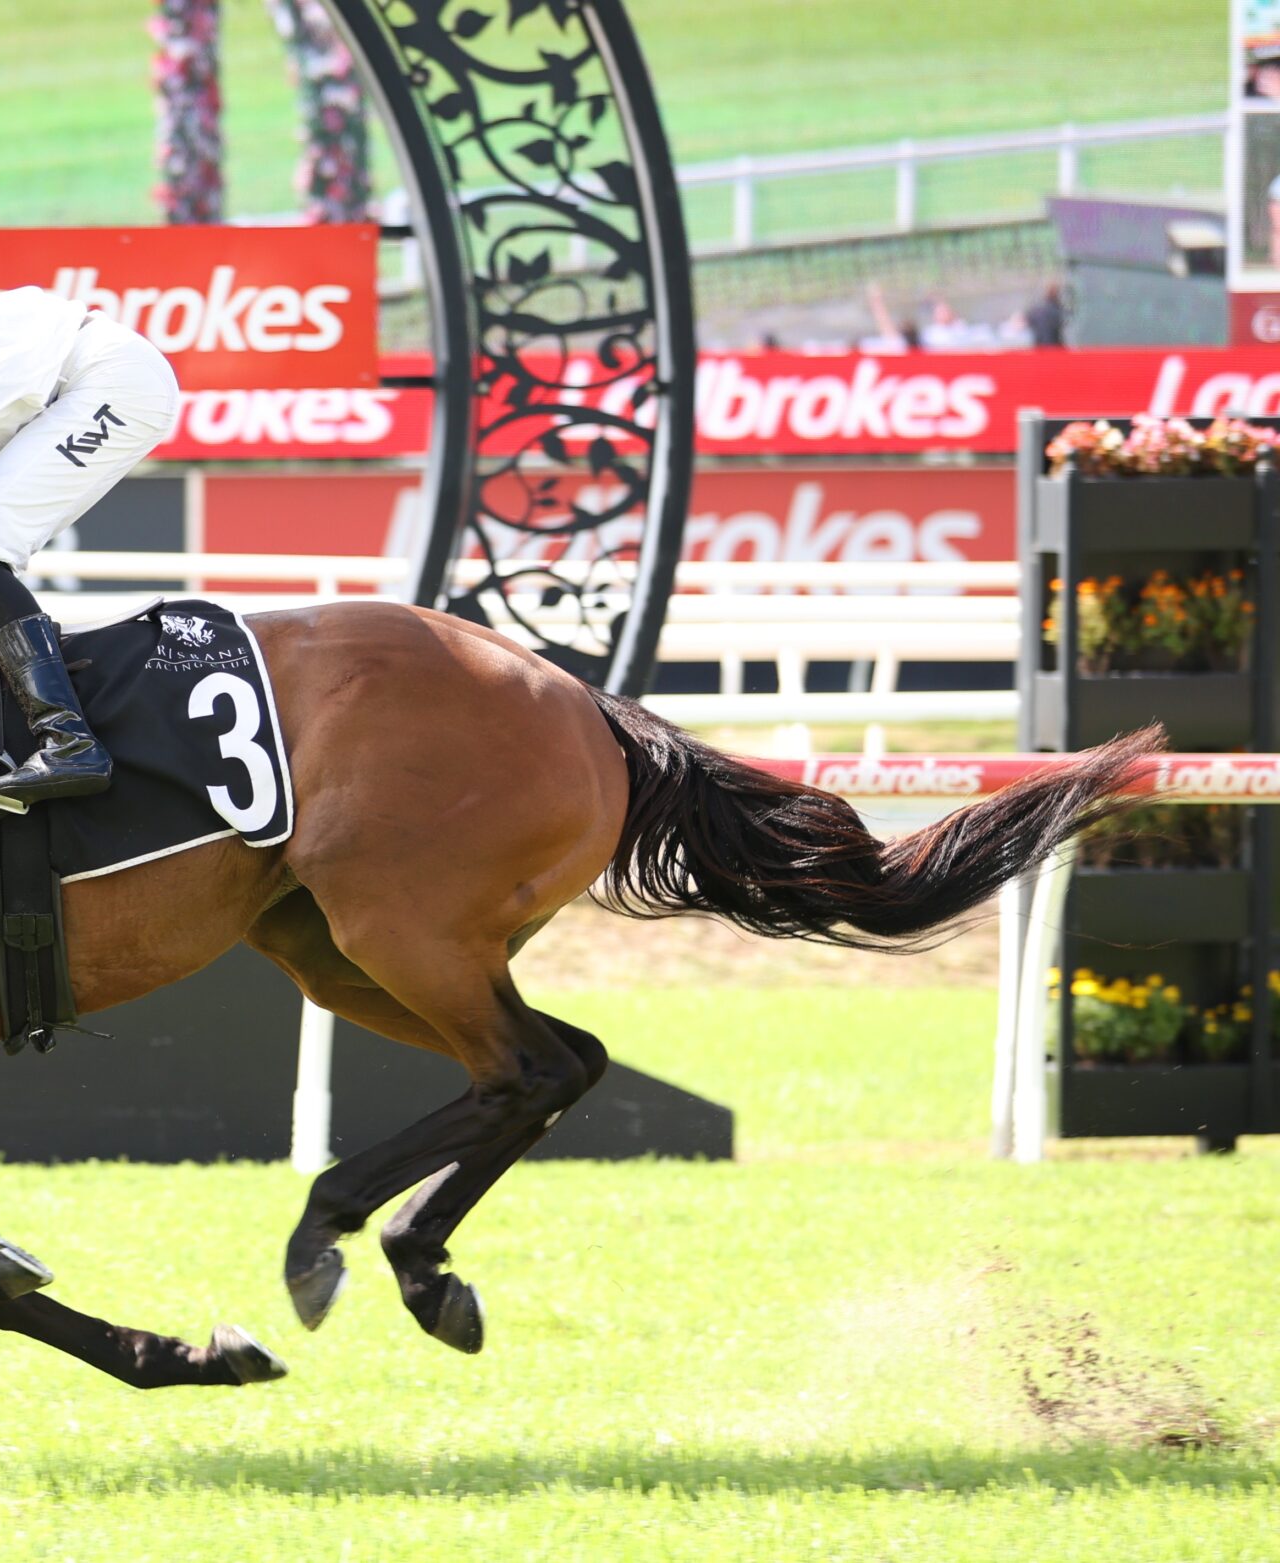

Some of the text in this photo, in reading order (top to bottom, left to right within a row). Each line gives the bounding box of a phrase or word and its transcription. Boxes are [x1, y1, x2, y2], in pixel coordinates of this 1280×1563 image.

[144, 660, 203, 673] RACING
[188, 671, 278, 833] 3
[802, 757, 984, 794] Ladbrokes
